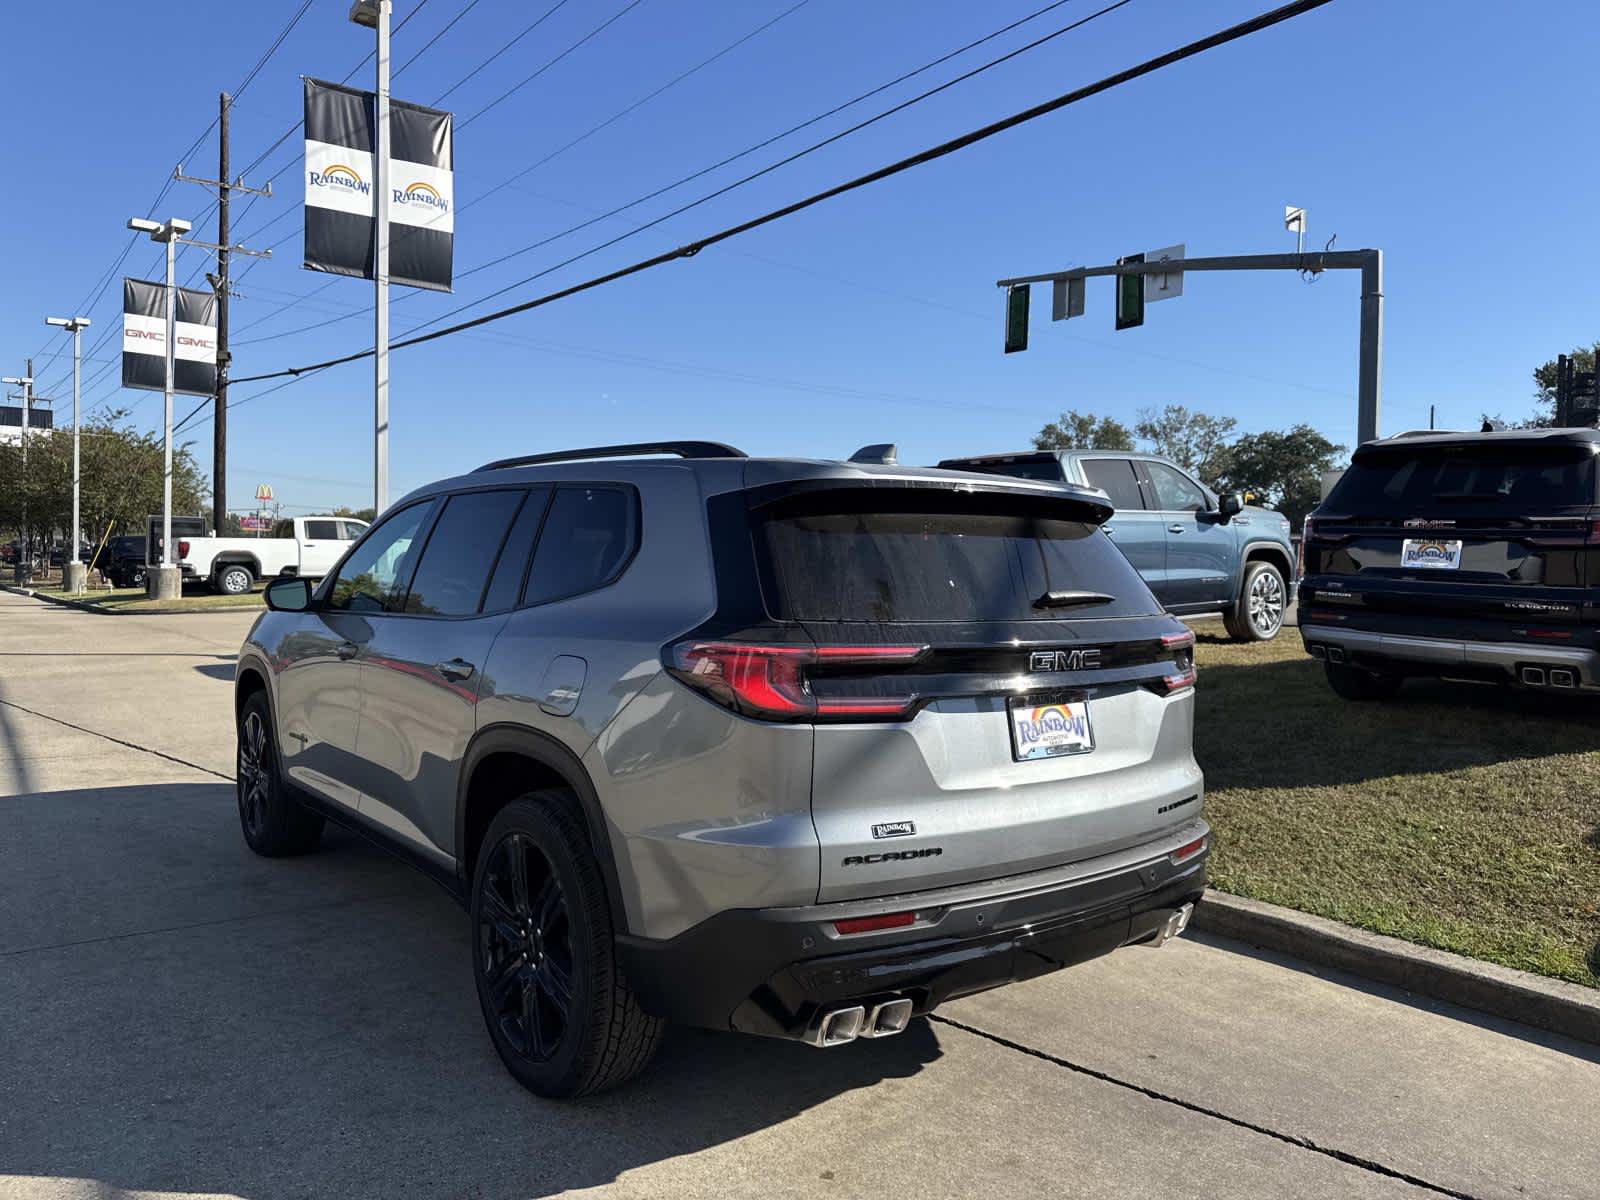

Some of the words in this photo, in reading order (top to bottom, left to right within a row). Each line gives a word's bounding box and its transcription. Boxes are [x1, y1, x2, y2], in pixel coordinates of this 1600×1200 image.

[309, 171, 372, 196] RAINBOW
[392, 188, 449, 212] RAINBOW
[125, 328, 165, 342] GMC
[177, 336, 216, 350] GMC
[1407, 550, 1456, 562] RAINBOW
[1029, 649, 1101, 672] GMC
[1018, 715, 1086, 747] RAINBOW
[842, 847, 943, 866] ACADIA
